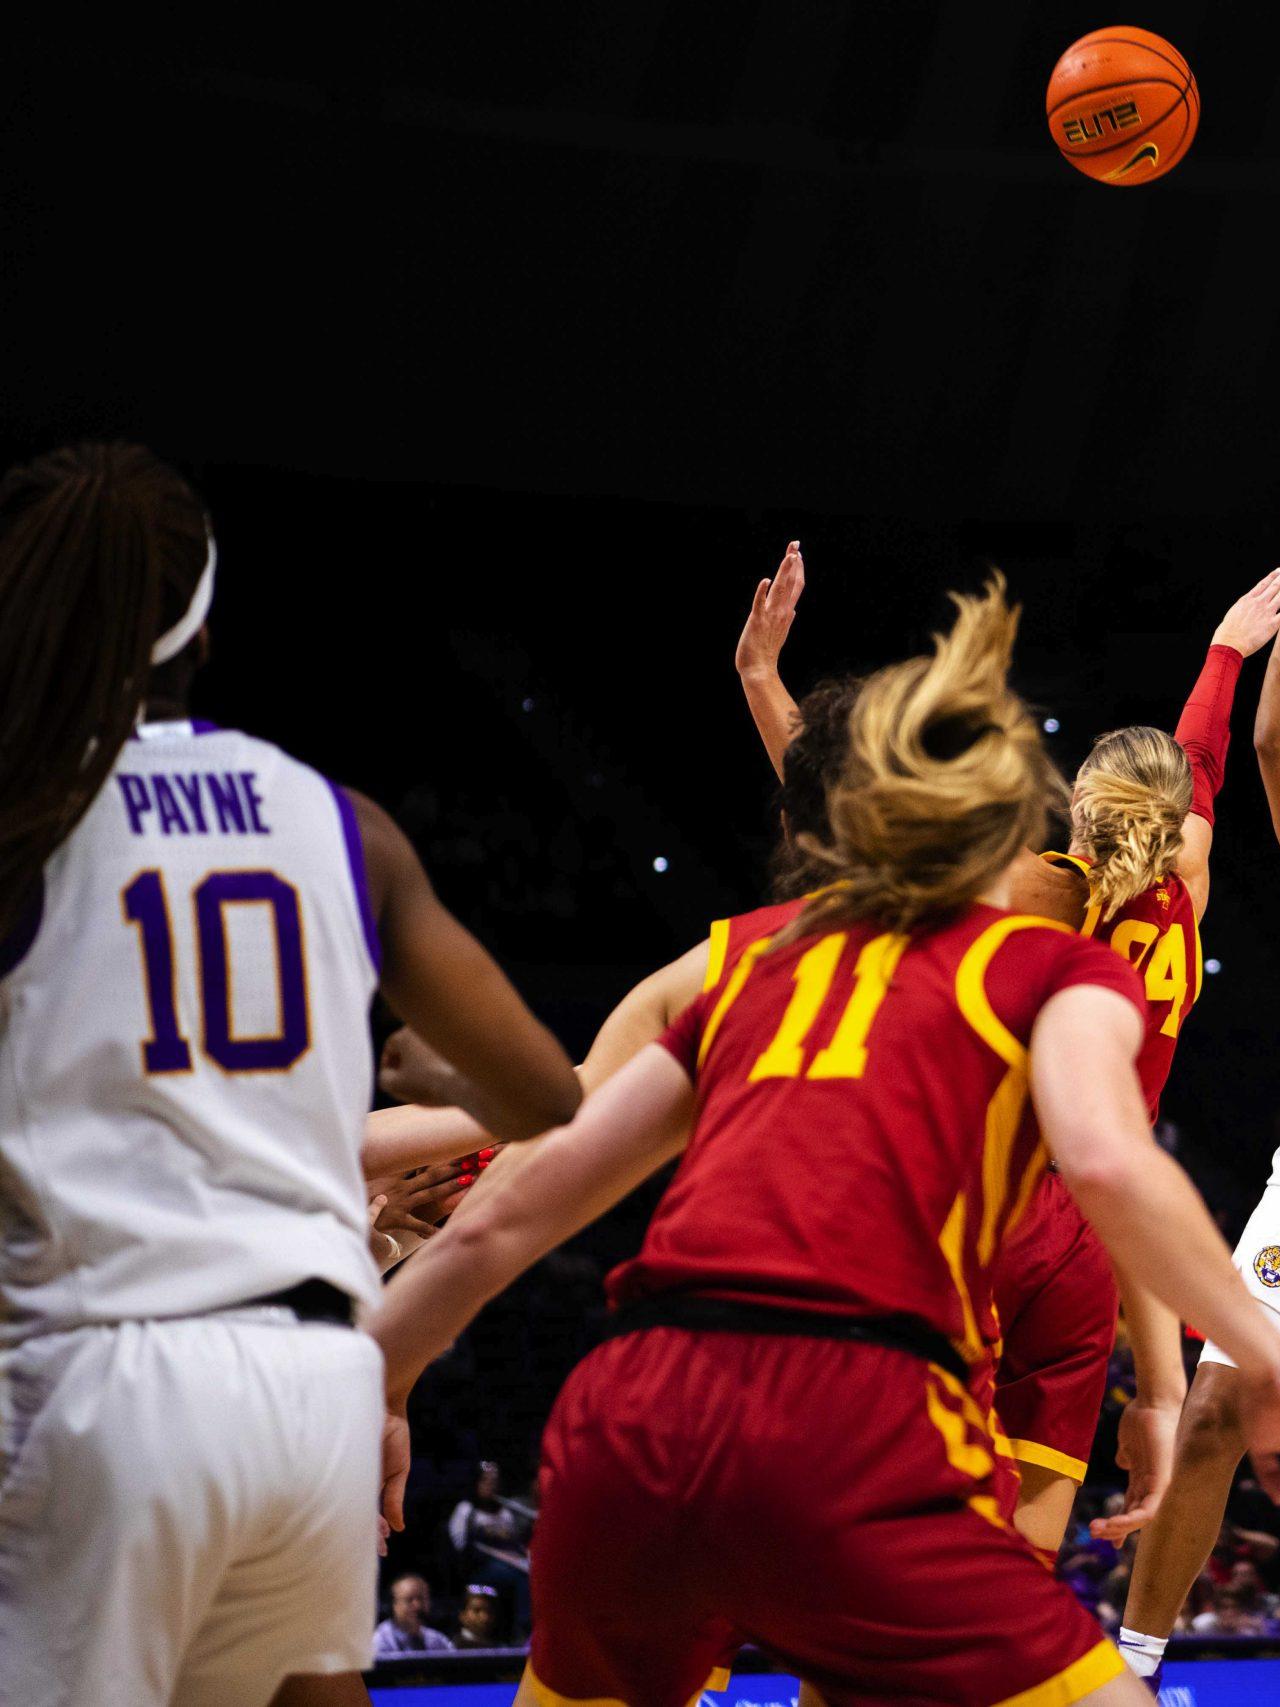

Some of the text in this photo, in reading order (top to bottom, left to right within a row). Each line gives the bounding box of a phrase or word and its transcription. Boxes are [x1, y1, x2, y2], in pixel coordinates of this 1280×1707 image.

[1062, 101, 1141, 145] ELITE
[116, 771, 270, 836] PAYNE
[119, 866, 313, 1077] 10
[748, 931, 910, 1083] 11
